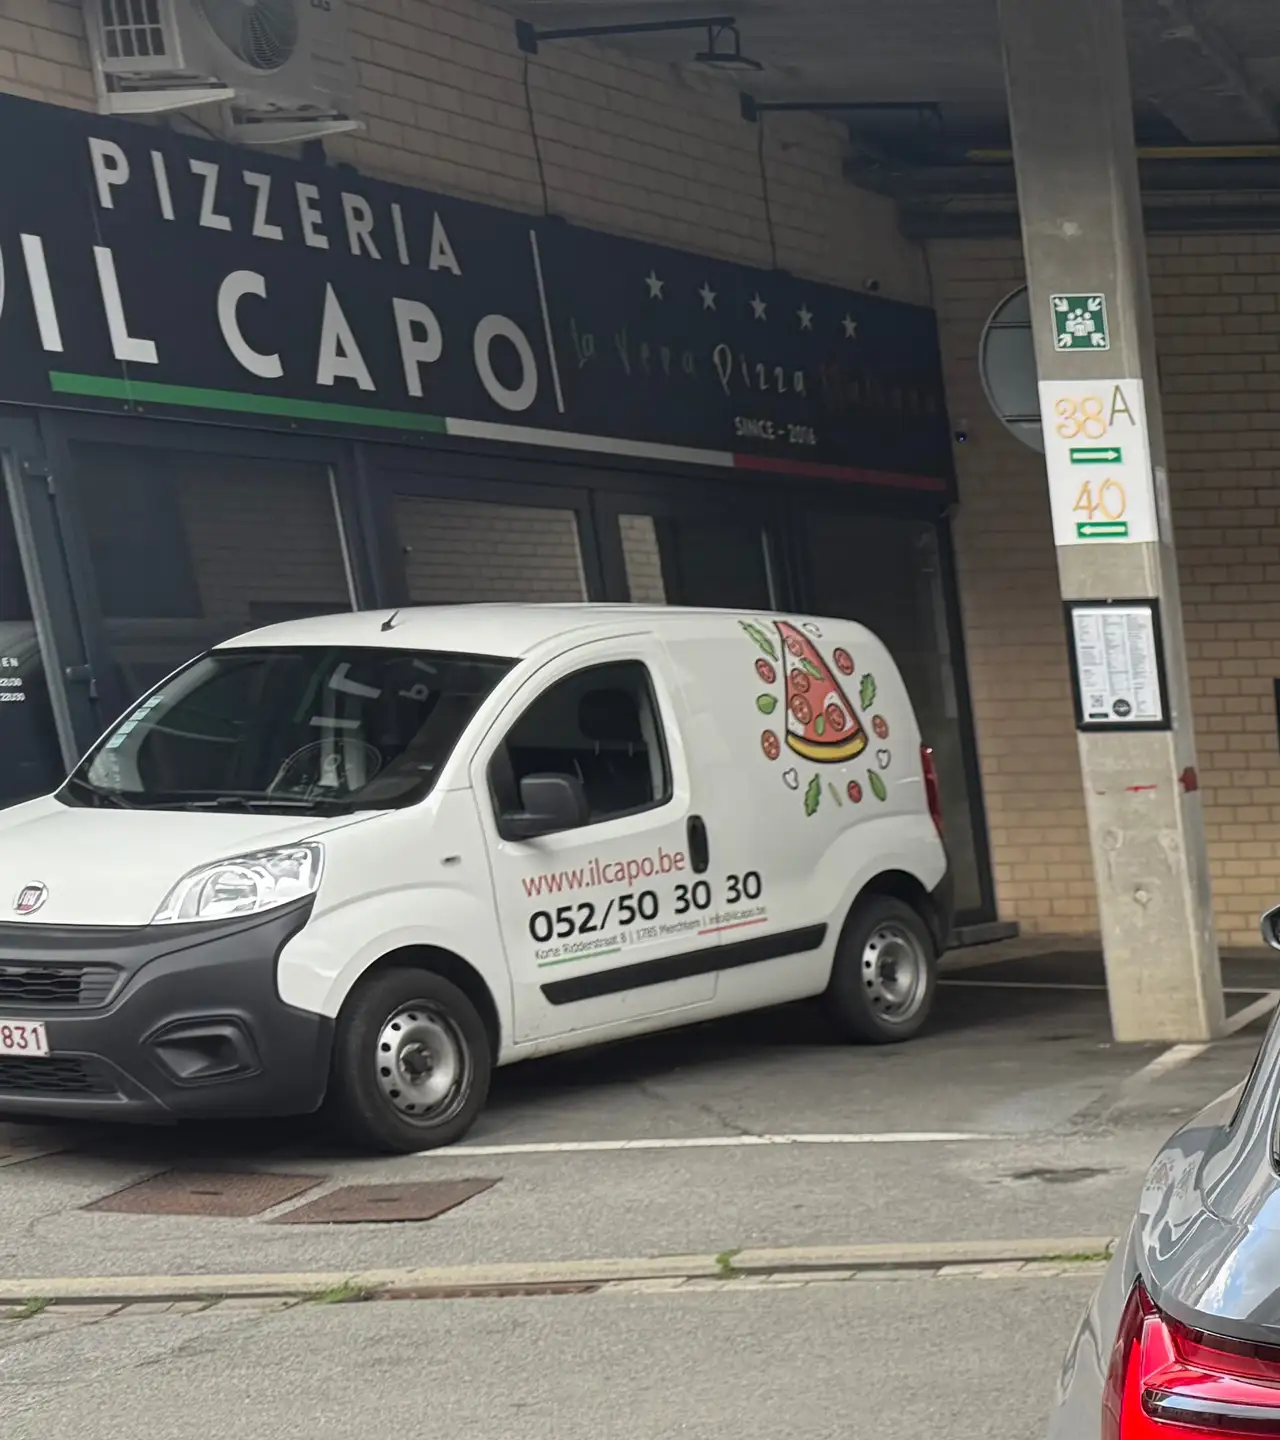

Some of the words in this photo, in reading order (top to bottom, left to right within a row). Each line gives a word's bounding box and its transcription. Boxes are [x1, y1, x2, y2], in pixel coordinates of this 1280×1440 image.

[88, 137, 462, 276] PIZZERIA
[20, 233, 159, 364] IL
[217, 269, 538, 412] CAPO
[712, 343, 807, 397] Pizza
[734, 416, 776, 440] SINCE
[1072, 477, 1127, 521] 40
[522, 847, 686, 897] www.ilcapo.be
[528, 889, 660, 943] 052/50
[673, 880, 712, 914] 30
[725, 870, 763, 904] 30
[1, 1025, 42, 1050] 831
